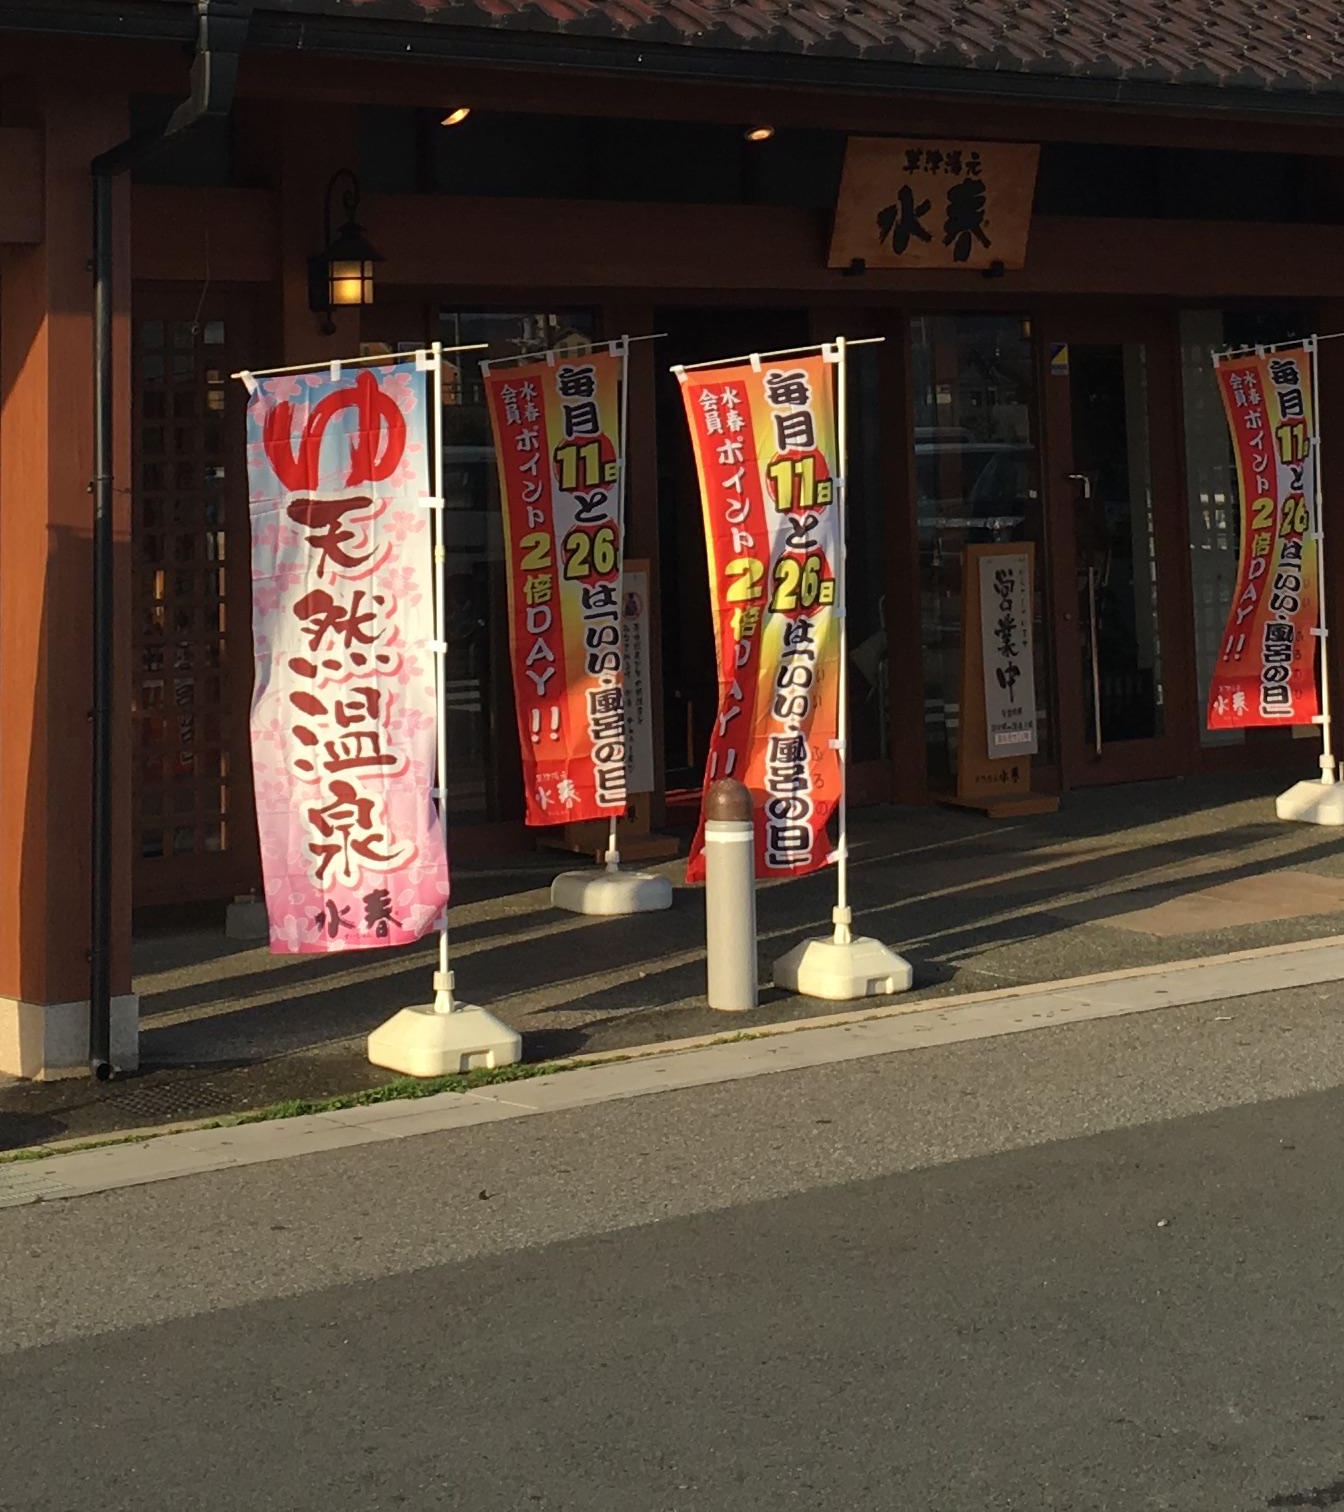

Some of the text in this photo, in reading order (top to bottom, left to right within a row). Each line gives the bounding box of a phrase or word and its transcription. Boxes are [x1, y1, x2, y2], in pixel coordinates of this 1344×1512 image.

[876, 178, 991, 262] 水春
[500, 383, 521, 425] 会員
[520, 381, 541, 423] 水春
[699, 388, 723, 435] 会員
[720, 386, 745, 433] 水春
[1229, 373, 1248, 407] 会員
[1243, 371, 1261, 406] 水春
[263, 369, 407, 492] ゆ
[993, 567, 1021, 704] 営業中
[286, 495, 402, 881] 天然温泉
[1213, 691, 1249, 717] 水春
[536, 779, 581, 811] 水春
[314, 888, 403, 939] 水春
